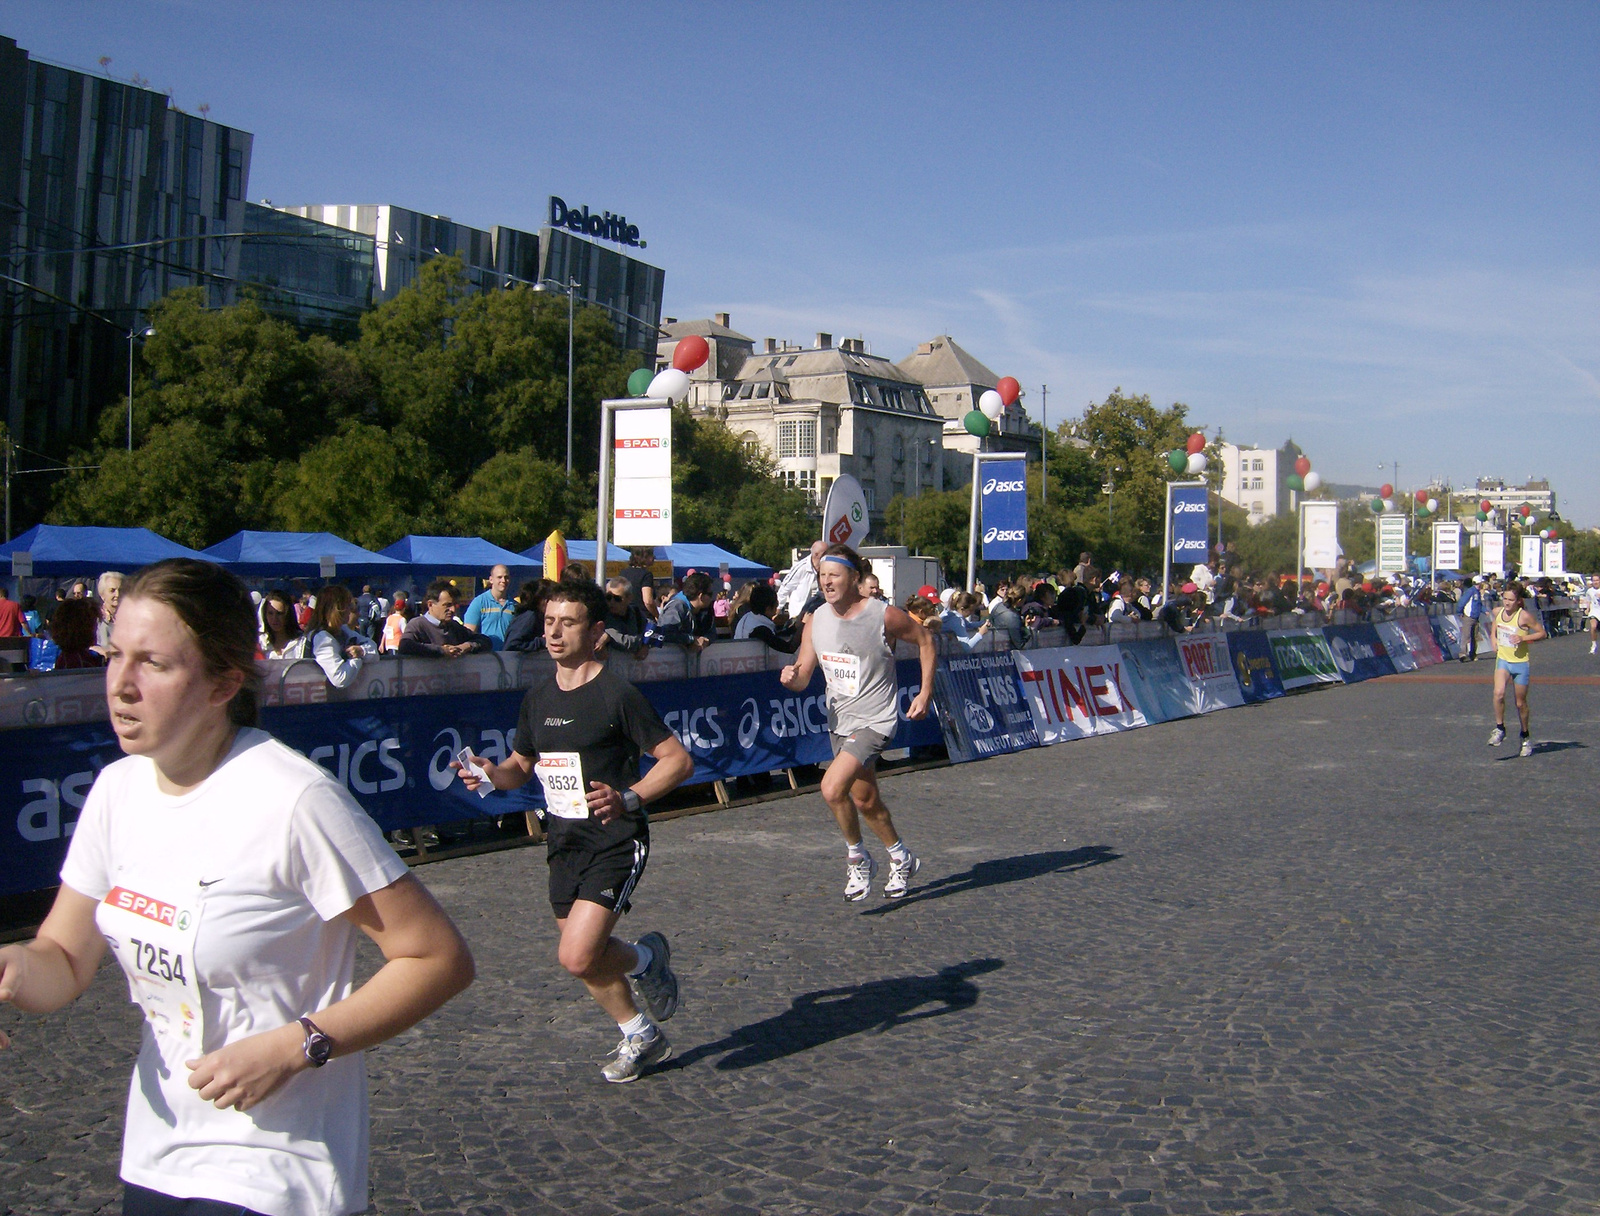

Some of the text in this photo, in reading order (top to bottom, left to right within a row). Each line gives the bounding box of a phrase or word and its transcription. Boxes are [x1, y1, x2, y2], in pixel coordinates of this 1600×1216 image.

[623, 438, 660, 448] SPAR
[995, 480, 1025, 493] asics
[1184, 503, 1206, 513] asics
[623, 509, 660, 519] SPAR
[996, 530, 1025, 541] asics
[1184, 540, 1206, 549] asics
[834, 668, 857, 680] 8044
[977, 674, 1018, 708] FUSS
[544, 717, 563, 727] RUN
[538, 759, 568, 768] PAR
[547, 774, 579, 791] 8532
[117, 891, 175, 924] SPAR
[131, 938, 187, 986] 7254
